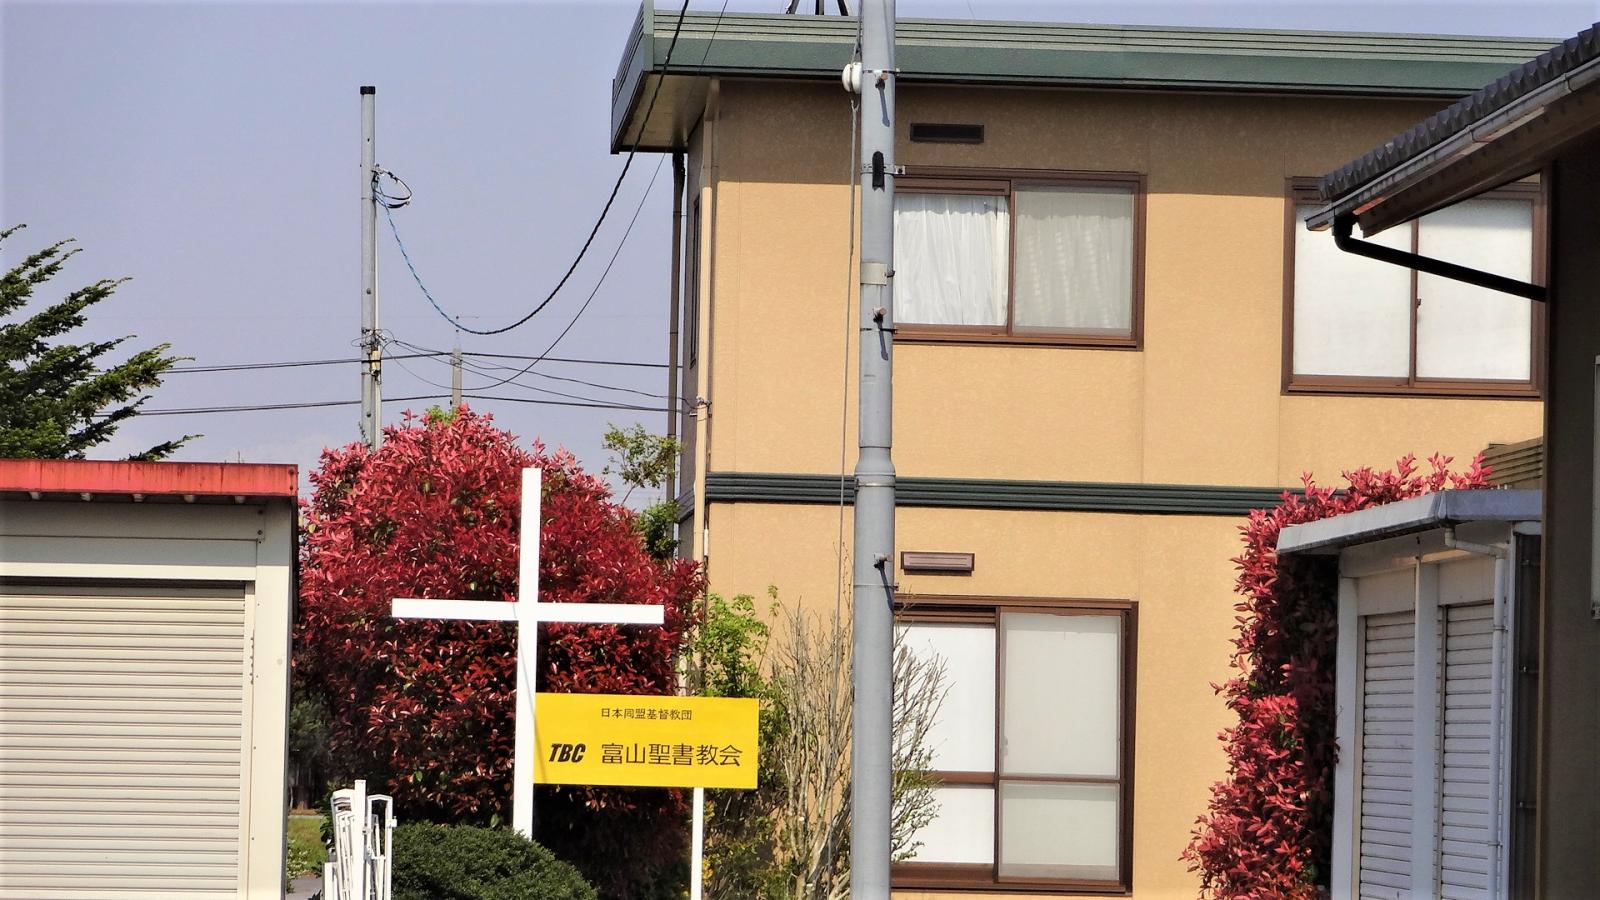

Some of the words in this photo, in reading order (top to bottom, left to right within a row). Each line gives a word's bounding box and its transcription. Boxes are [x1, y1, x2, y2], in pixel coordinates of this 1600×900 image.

[601, 708, 692, 720] 日本同盟基督教団
[549, 743, 586, 763] TBC
[601, 743, 743, 766] 富山聖書教会
